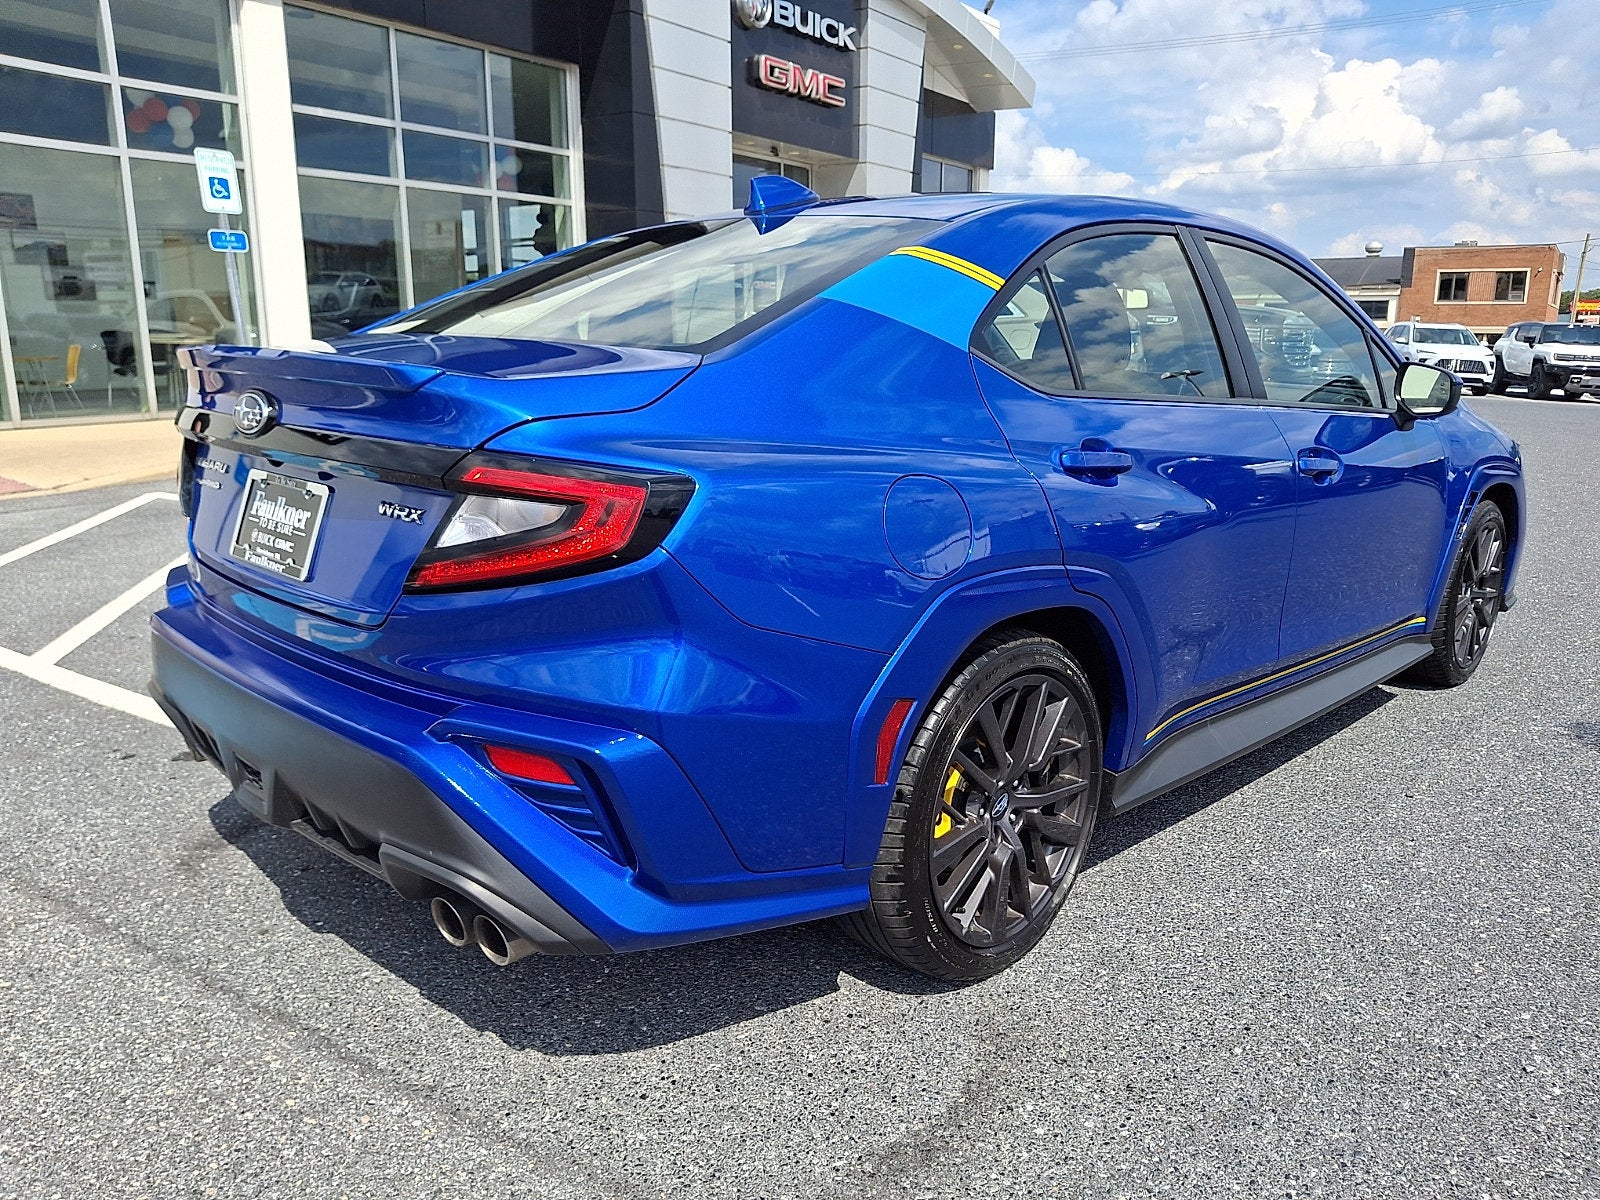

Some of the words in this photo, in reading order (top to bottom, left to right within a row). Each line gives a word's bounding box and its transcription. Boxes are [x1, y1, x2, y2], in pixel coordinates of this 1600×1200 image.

[773, 0, 857, 51] BUICK
[758, 54, 846, 107] GMC
[250, 490, 311, 530] Faulkner
[378, 502, 427, 525] WRX
[260, 516, 268, 528] TO
[267, 520, 277, 531] BE
[276, 522, 294, 536] SURE
[257, 531, 276, 547] BUICK
[274, 537, 295, 553] GMC
[244, 550, 286, 573] Faulkner
